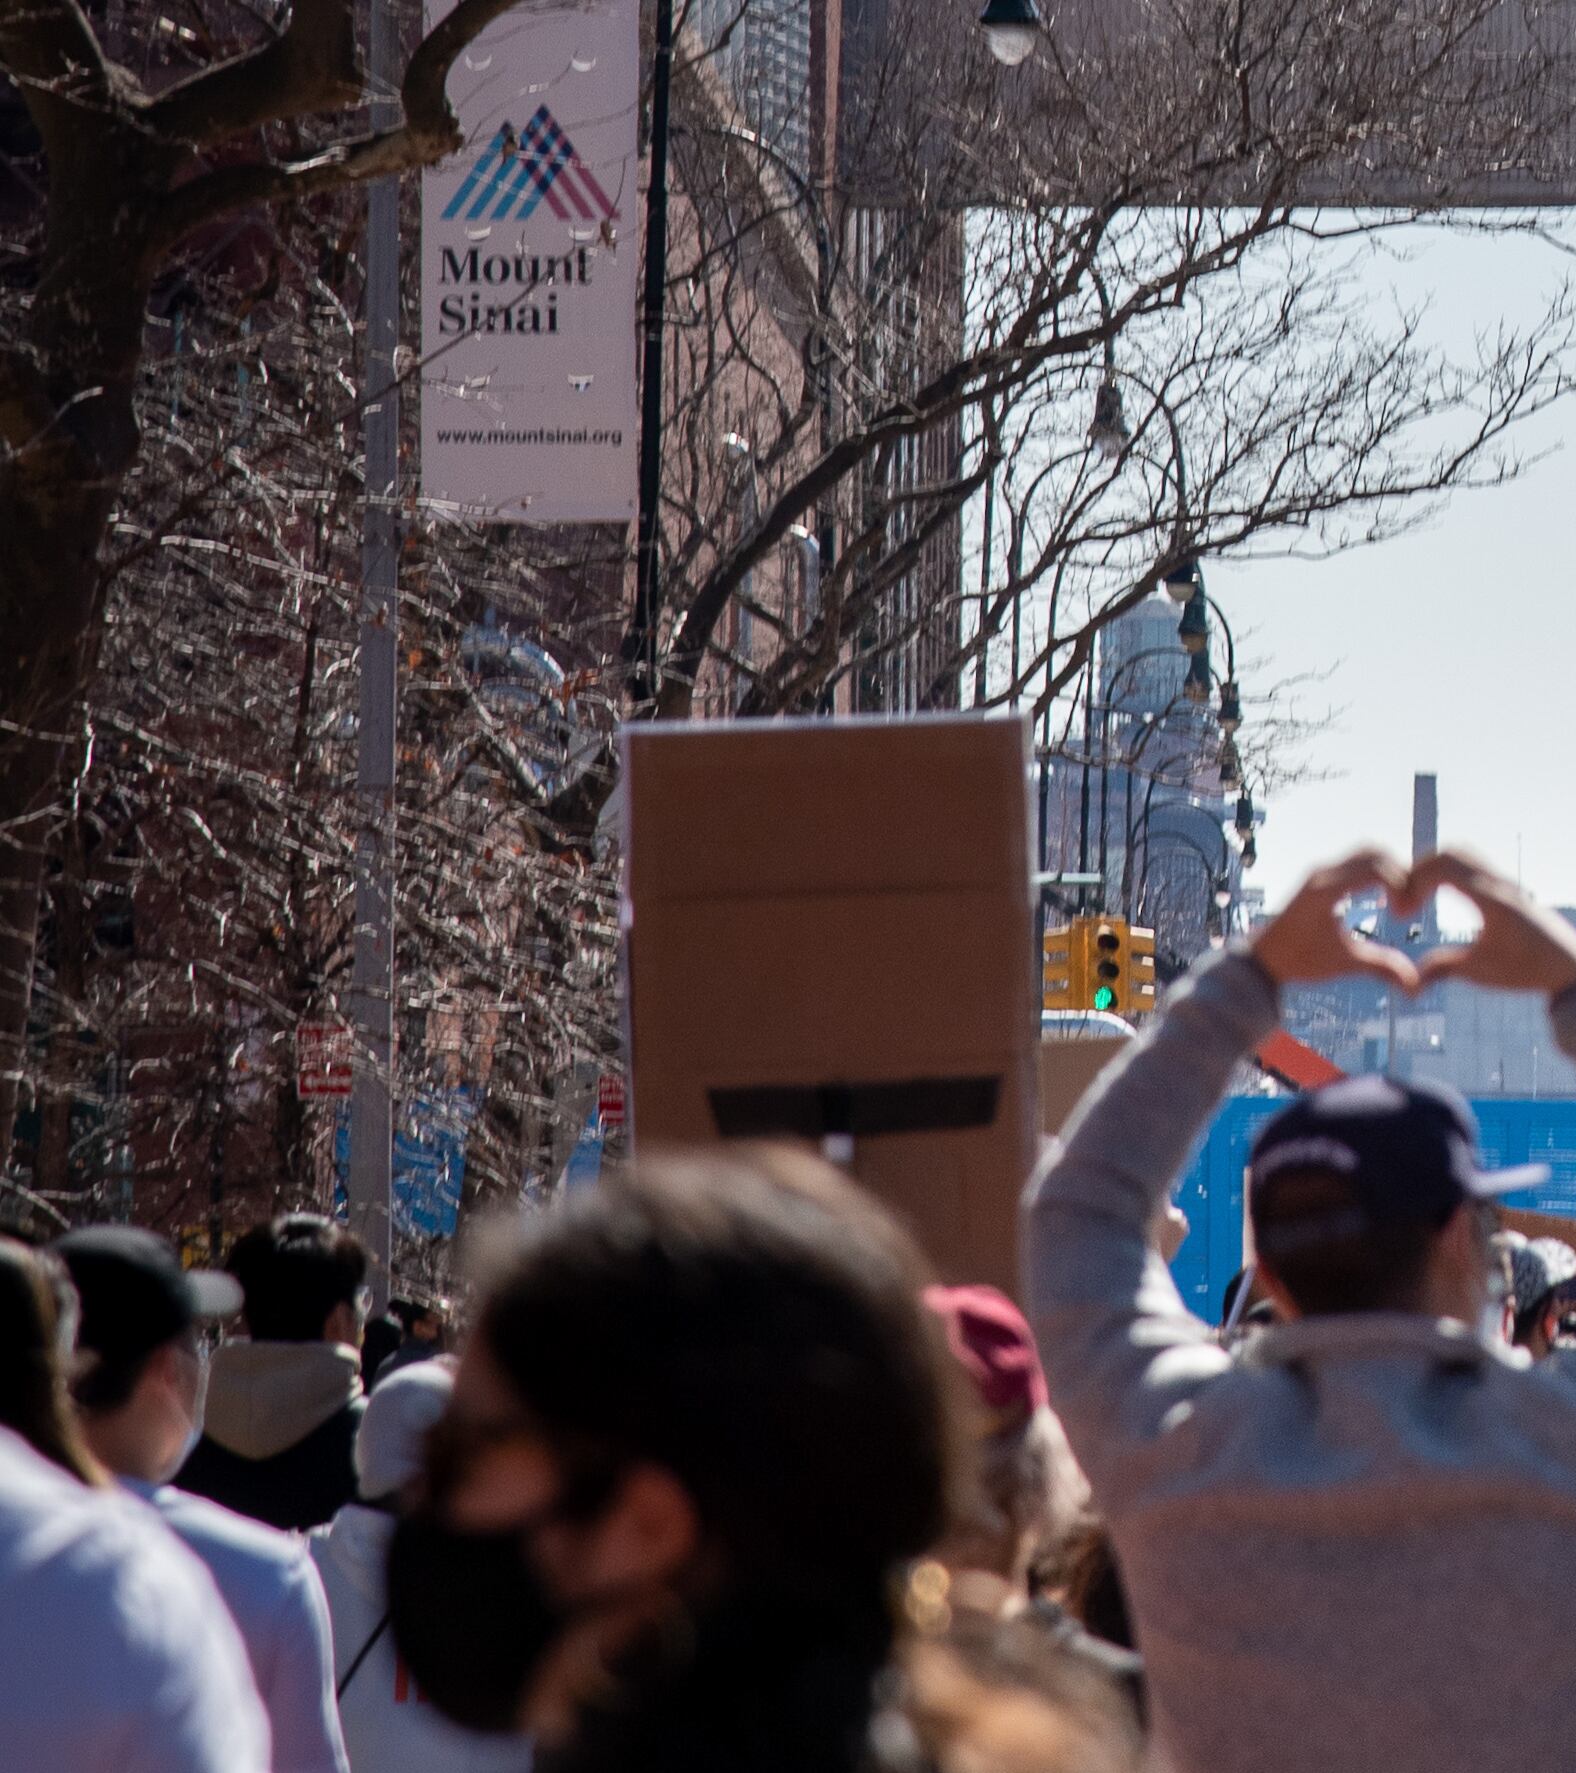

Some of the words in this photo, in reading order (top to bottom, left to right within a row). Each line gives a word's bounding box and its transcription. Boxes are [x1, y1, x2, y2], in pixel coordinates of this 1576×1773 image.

[438, 246, 592, 286] Mount
[438, 292, 560, 335] Sinai
[437, 428, 622, 447] www.mountsinai.org
